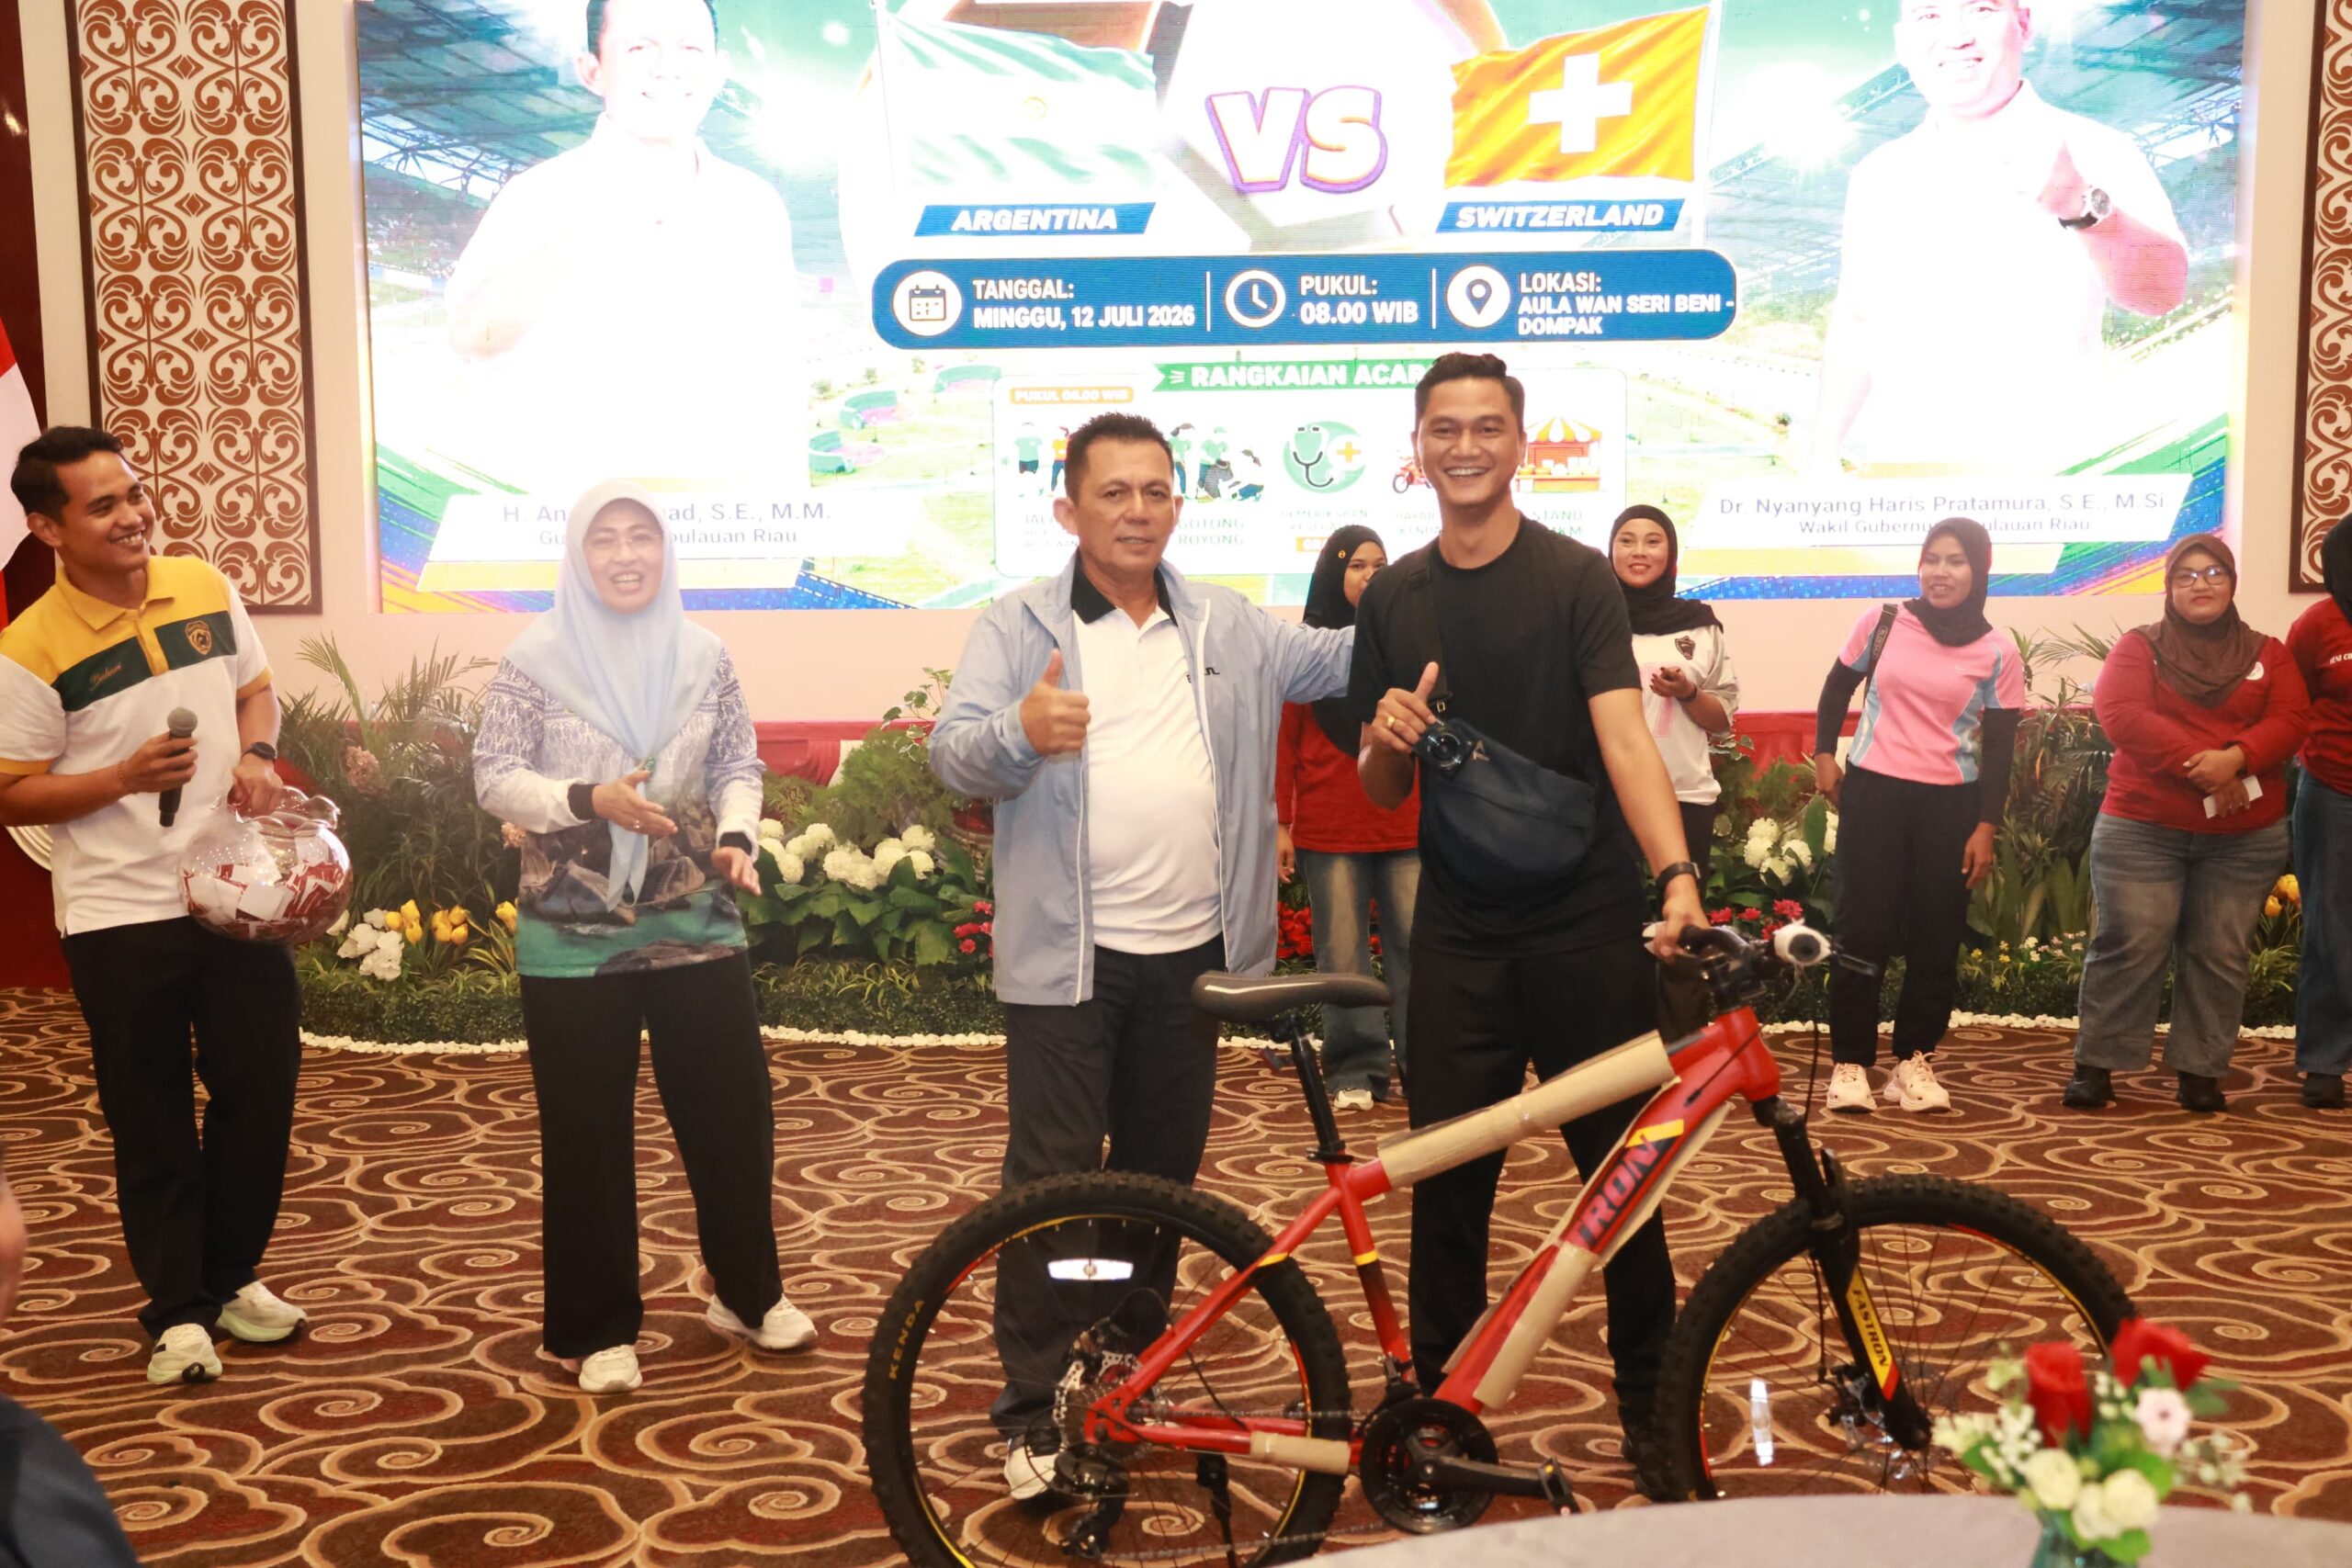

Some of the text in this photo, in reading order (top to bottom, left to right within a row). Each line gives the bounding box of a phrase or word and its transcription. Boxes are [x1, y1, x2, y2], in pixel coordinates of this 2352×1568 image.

[1204, 85, 1387, 194] VS
[951, 208, 1117, 231] ARGENTINA
[1455, 204, 1664, 228] SWITZERLAND
[972, 278, 1074, 299] TANGGAL:
[1300, 275, 1378, 296] PUKUL:
[1520, 272, 1601, 293] LOKASI:
[1299, 300, 1419, 324] 08.00 WIB
[1517, 296, 1571, 315] AULA
[1575, 295, 1623, 314] WAN
[1626, 294, 1669, 313] SERI
[1675, 294, 1721, 312] BENI
[973, 304, 1195, 331] MINGGU, 12 JULI 2026
[1518, 316, 1602, 335] DOMPAK
[1191, 363, 1427, 387] RANGKAIAN ACAR
[503, 505, 526, 522] H.
[772, 502, 831, 519] M.M.
[1756, 498, 1862, 517] Nyanyang
[1870, 496, 1925, 513] Haris
[753, 527, 797, 543] Riau
[1799, 519, 1848, 534] Wakil
[1855, 519, 1931, 534] Gubernu
[2050, 517, 2090, 531] Riau
[1851, 1289, 1890, 1367] FASTRON
[888, 1299, 925, 1380] KENDA
